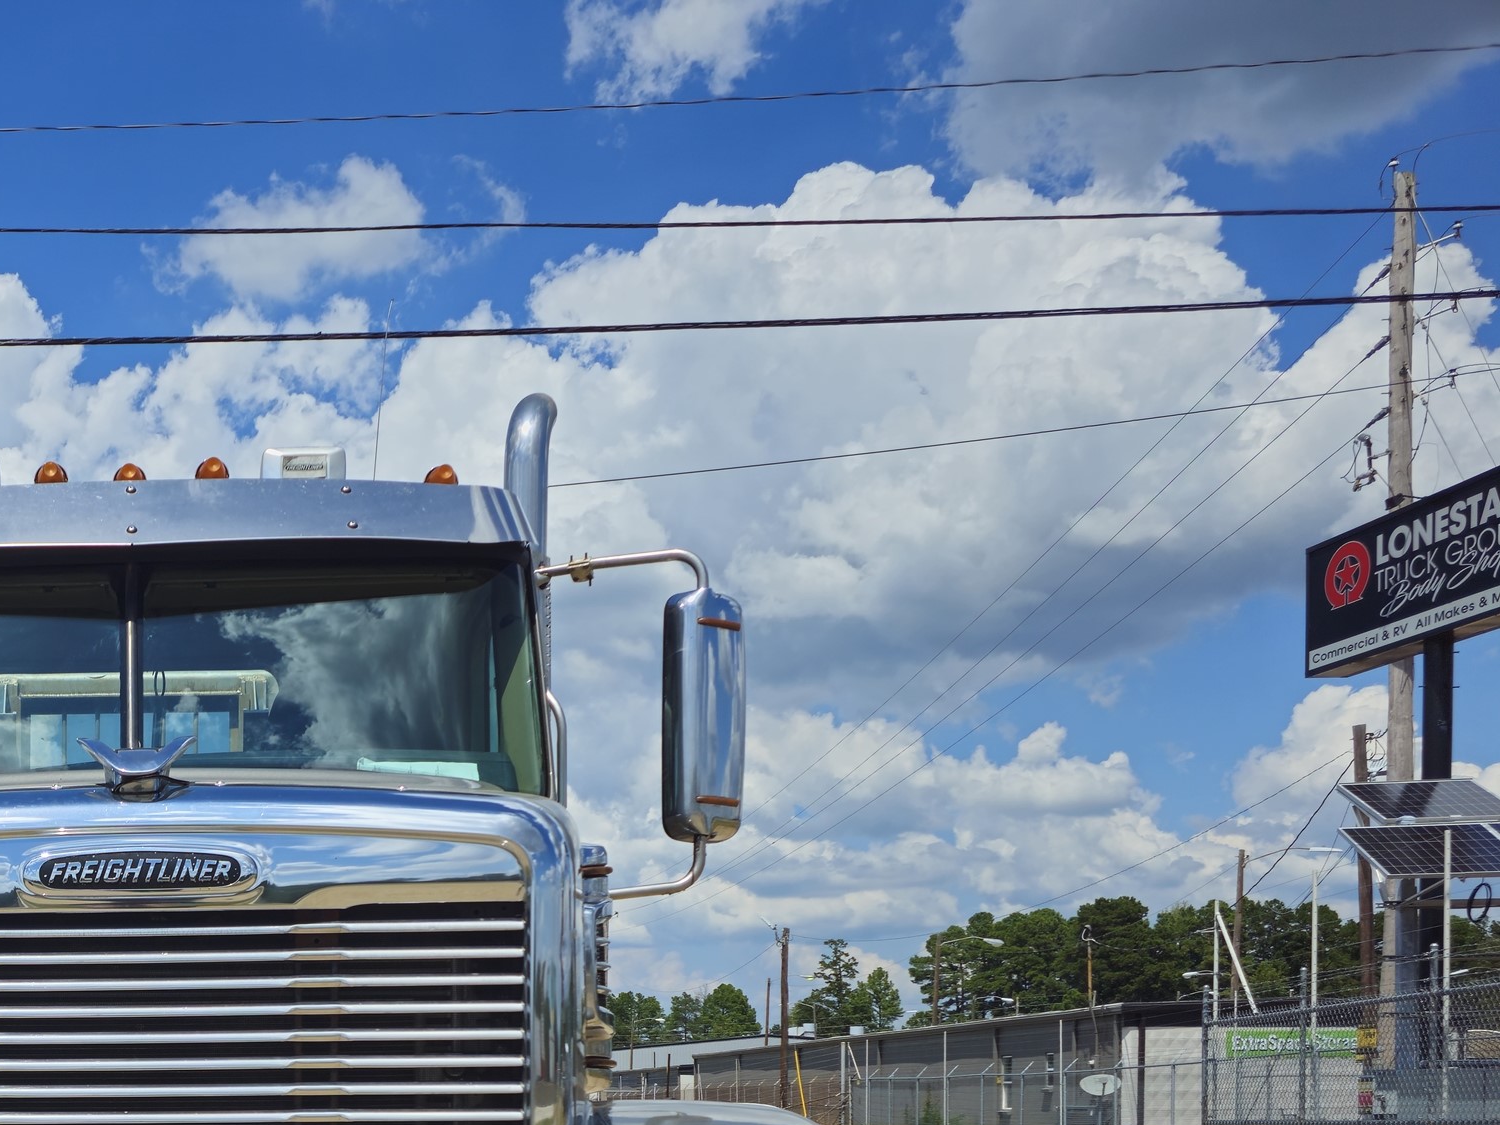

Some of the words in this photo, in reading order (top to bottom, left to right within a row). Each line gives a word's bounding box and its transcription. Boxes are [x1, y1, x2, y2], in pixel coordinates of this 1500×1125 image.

[1374, 547, 1438, 592] TRUCK
[1444, 524, 1500, 565] GRO
[1380, 567, 1446, 617] Body
[1312, 634, 1378, 664] Commercial
[1381, 630, 1390, 641] &
[1393, 623, 1408, 637] RV
[1415, 615, 1431, 630] All
[1434, 602, 1475, 623] Makes
[1479, 596, 1488, 608] &
[49, 857, 233, 884] FREIGHTLINER
